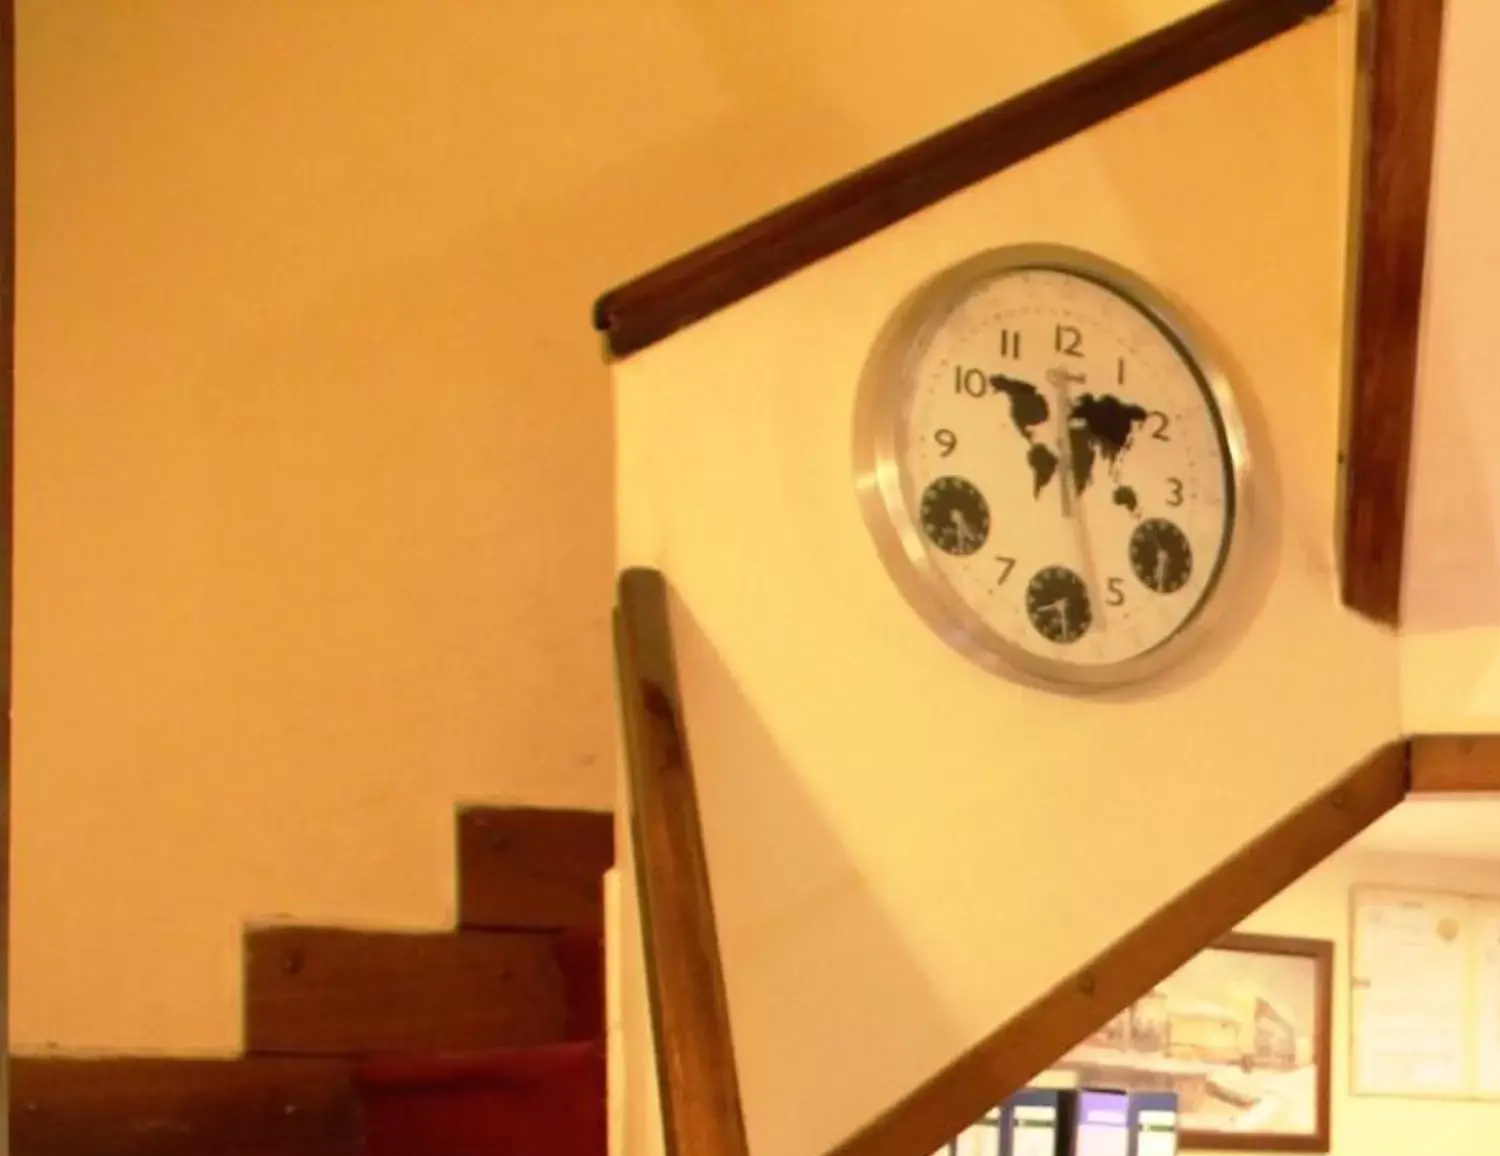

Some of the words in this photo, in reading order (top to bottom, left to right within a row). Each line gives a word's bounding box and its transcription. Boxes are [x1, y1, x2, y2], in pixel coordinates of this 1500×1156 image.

[1000, 329, 1021, 361] 11
[1055, 324, 1085, 358] 12
[954, 366, 988, 398] 10
[1116, 356, 1125, 385] 1
[1150, 411, 1171, 441] 2
[934, 429, 957, 458] 9
[1165, 477, 1184, 506] 3
[994, 556, 1017, 587] 7
[1105, 577, 1125, 607] 5
